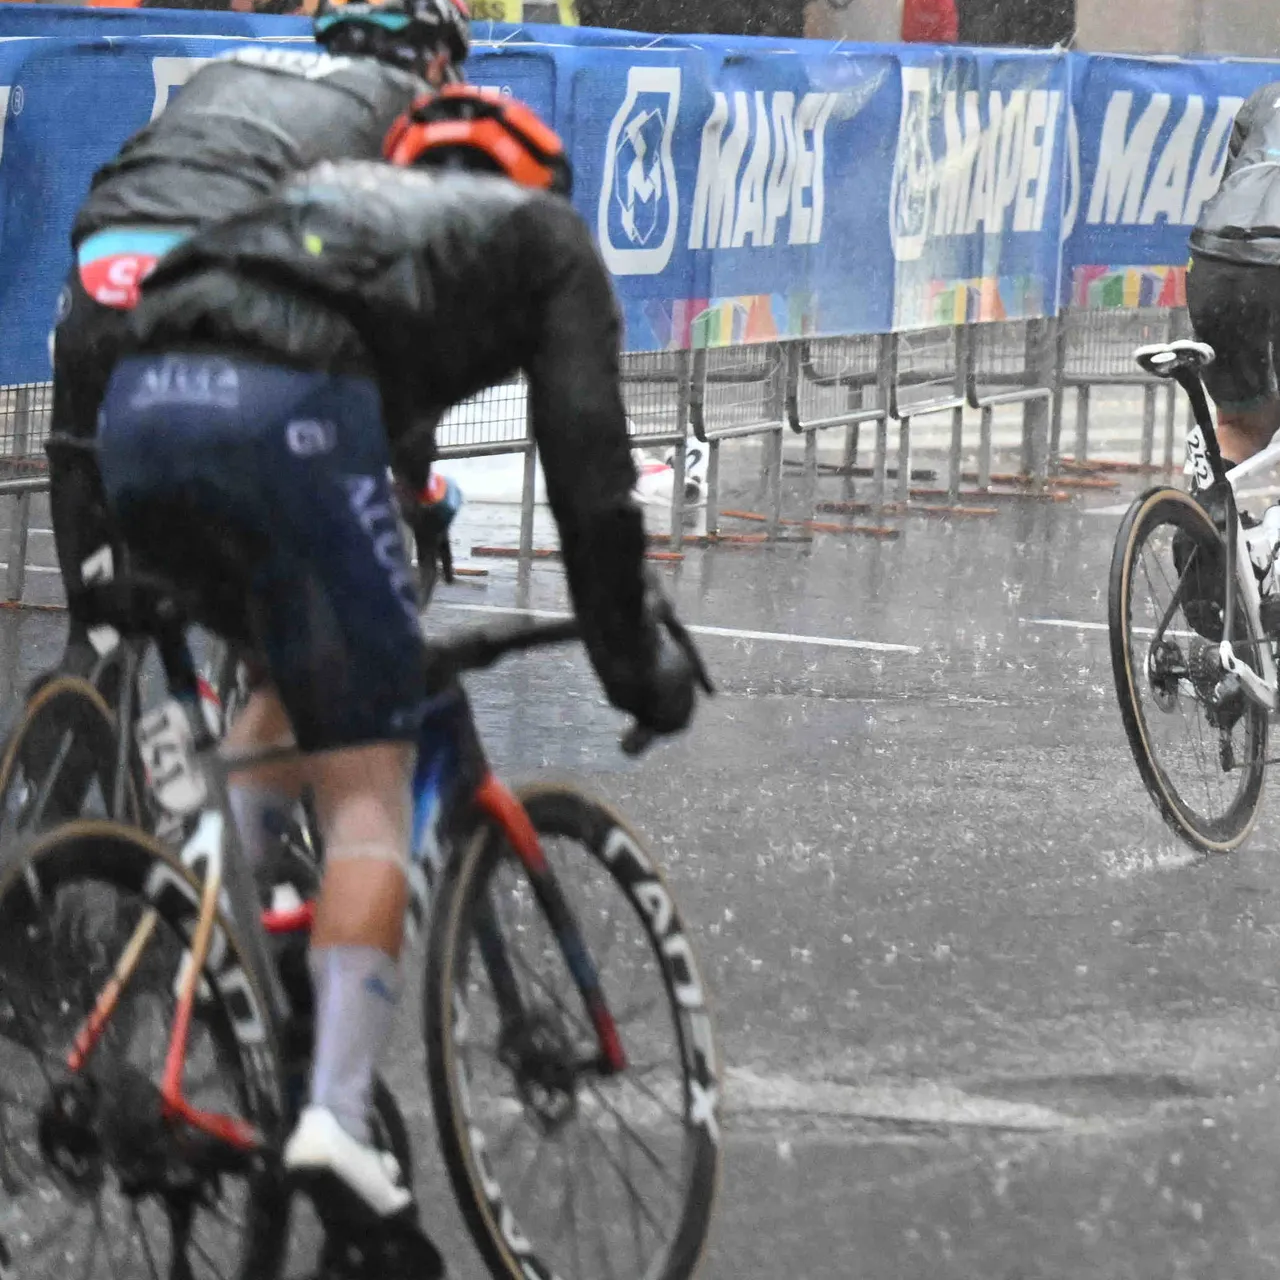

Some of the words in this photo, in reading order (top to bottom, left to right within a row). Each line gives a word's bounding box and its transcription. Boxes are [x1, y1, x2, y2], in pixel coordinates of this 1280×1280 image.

[688, 91, 838, 250] MAPEI
[934, 90, 1062, 236] MAPEI
[1086, 90, 1246, 226] MAP
